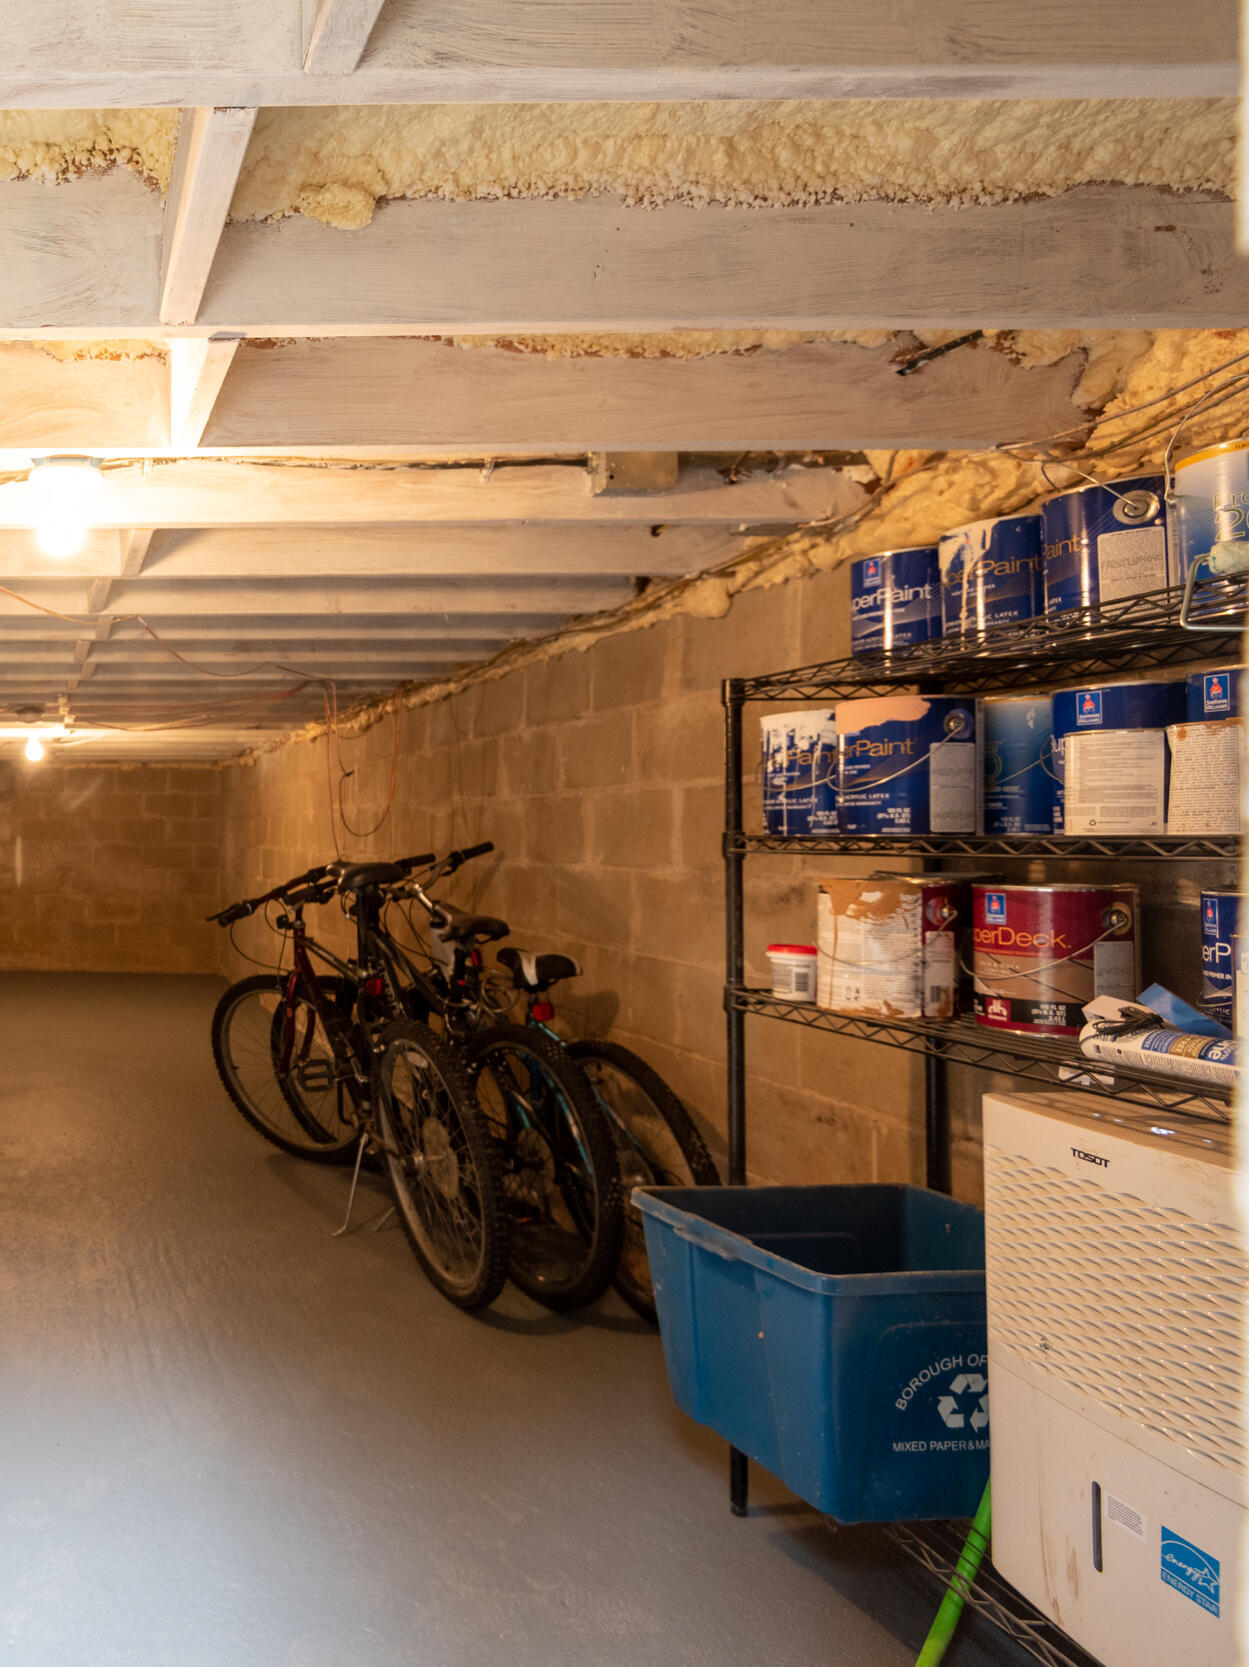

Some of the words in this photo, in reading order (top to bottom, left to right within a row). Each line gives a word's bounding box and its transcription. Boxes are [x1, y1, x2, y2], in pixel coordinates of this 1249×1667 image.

[1070, 1147, 1110, 1168] TOSOT
[895, 1355, 963, 1411] BOROUGH
[892, 1441, 927, 1452] MIXED
[1161, 1571, 1193, 1598] ENERGY
[1195, 1593, 1218, 1614] STAR
